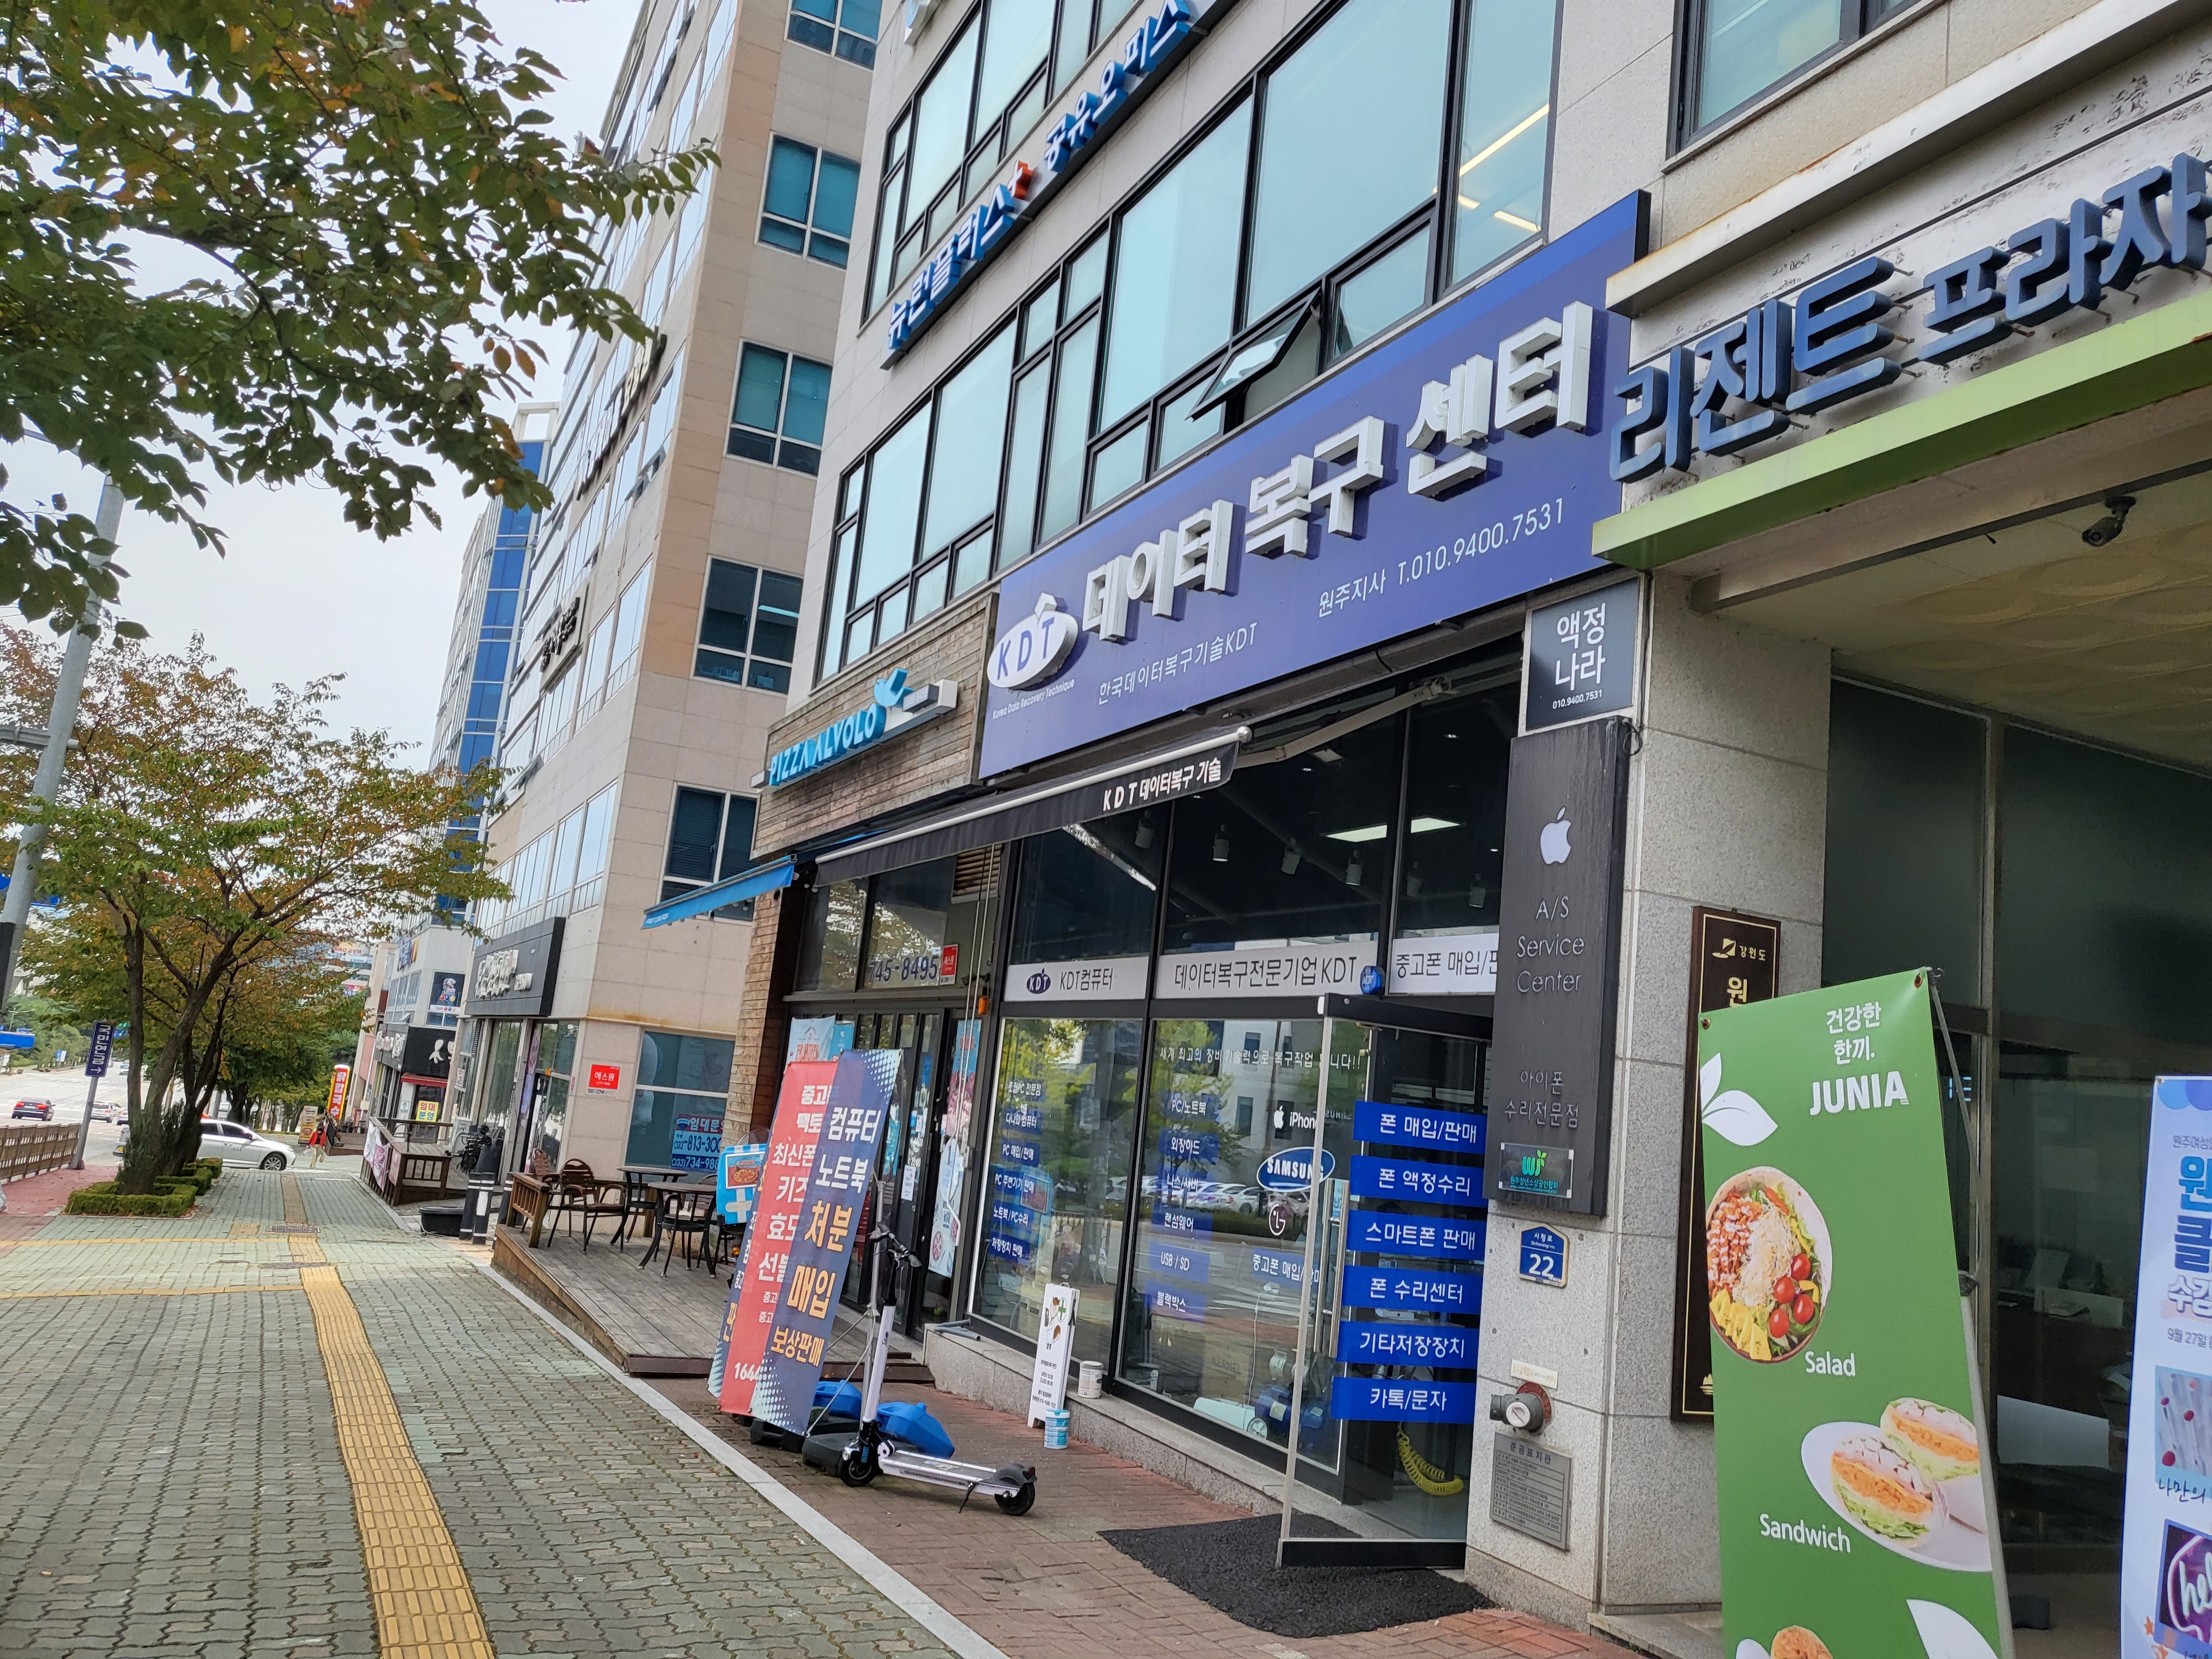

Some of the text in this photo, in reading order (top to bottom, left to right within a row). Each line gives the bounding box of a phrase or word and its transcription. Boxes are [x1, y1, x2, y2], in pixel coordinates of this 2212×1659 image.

[1045, 0, 1190, 173] 공유오피스
[1610, 153, 2212, 483] 리젠트 프라자
[1082, 300, 1593, 641] 데이터 복구 센터
[1319, 498, 1563, 618] 원주지사 T.010.9400.7531
[1557, 602, 1605, 649] 액정
[997, 617, 1055, 680] KDT
[1099, 622, 1258, 706] 한국데이터복구기술KDT
[1555, 645, 1605, 691] 나라
[993, 679, 1074, 719] Korea Data Recovery Technique
[1552, 689, 1602, 709] 010.9400.7531
[1140, 765, 1194, 800] 데이터복구
[1196, 757, 1221, 784] 기술
[1535, 895, 1569, 921] A/S
[1517, 932, 1584, 958] Service
[1740, 946, 1766, 961] 강원도
[1175, 956, 1357, 990] 데이터복구전문기업KDT
[1396, 952, 1442, 978] 중고폰
[1029, 976, 1048, 991] KDT
[1060, 968, 1113, 990] KDT컴퓨터
[1517, 969, 1582, 993] Center
[1826, 1001, 1881, 1035] 건강한
[1178, 1048, 1201, 1062] 최고의
[1275, 1052, 1313, 1068] 복구작업
[1320, 1053, 1360, 1070] 니다!!
[1834, 1035, 1875, 1065] 한끼.
[594, 1072, 614, 1081] 에스원
[1026, 1082, 1041, 1096] 전문점
[1520, 1070, 1564, 1095] 아이폰
[801, 1085, 832, 1105] 중고
[1810, 1071, 1910, 1116] JUNIA
[419, 1111, 434, 1120] 분양
[421, 1102, 435, 1112] 임대
[1172, 1099, 1206, 1116] PC/노트북
[1504, 1100, 1579, 1129] 수리전문점
[828, 1107, 881, 1144] 컴퓨터
[1290, 1112, 1317, 1129] iPhon
[1380, 1113, 1396, 1134] 폰
[1404, 1117, 1477, 1144] 매입/판매
[1003, 1144, 1034, 1161] PC 매입/판매
[1171, 1136, 1200, 1155] 외장하드
[815, 1154, 869, 1194] 노트북
[995, 1173, 1034, 1194] PC 주변기기 판매
[1167, 1173, 1198, 1193] 나스/서버
[1379, 1168, 1470, 1197] 폰 액정수리
[805, 1199, 853, 1253] 처분
[1165, 1212, 1194, 1233] 랜섬웨어
[992, 1237, 1022, 1258] 저장장치 판매
[1365, 1222, 1475, 1250] 스마트폰 판매
[1534, 1233, 1553, 1242] 시청로
[1161, 1251, 1173, 1267] USB
[1180, 1256, 1190, 1271] SD
[1253, 1254, 1279, 1276] 중고폰
[1529, 1254, 1554, 1277] 22
[787, 1265, 836, 1320] 매입
[1157, 1291, 1186, 1313] 블랙박스
[1370, 1277, 1463, 1304] 폰 수리센터
[770, 1326, 825, 1368] 보상판매
[1360, 1332, 1465, 1359] 기타저장장치
[2168, 1327, 2182, 1343] 9월
[1804, 1351, 1856, 1377] Salad
[1370, 1387, 1447, 1411] 카톡/문자
[1510, 1442, 1551, 1464] 준공표지판
[2159, 1478, 2205, 1504] 나만의
[1760, 1514, 1850, 1553] Sandwich
